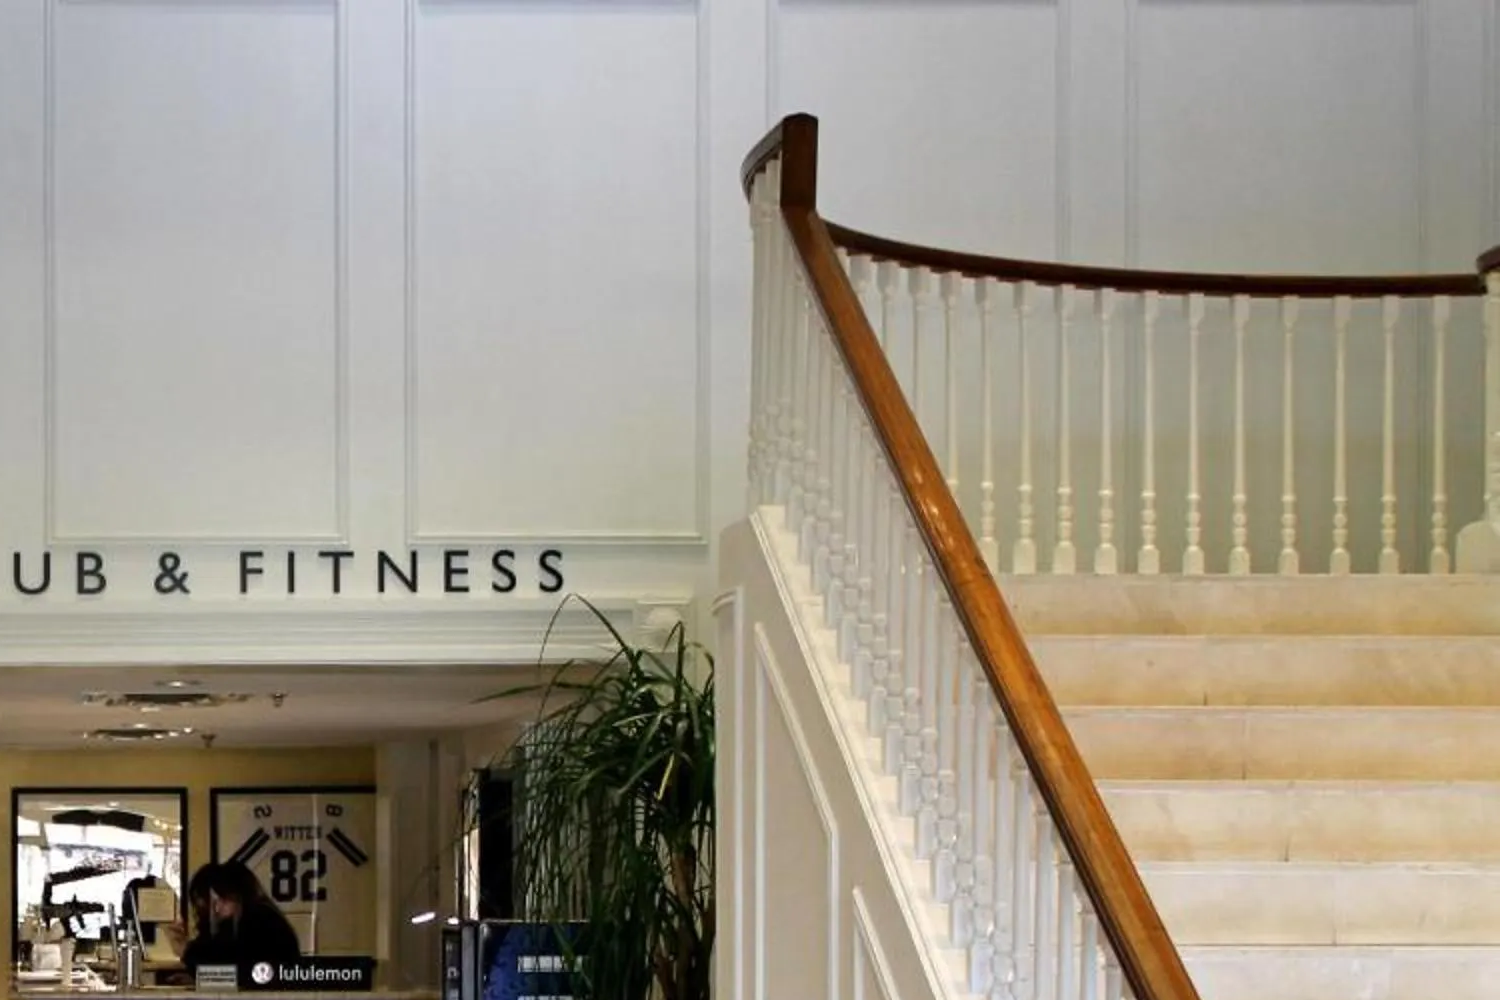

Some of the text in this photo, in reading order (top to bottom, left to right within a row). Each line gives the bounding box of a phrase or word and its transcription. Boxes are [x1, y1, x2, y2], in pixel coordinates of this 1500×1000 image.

[153, 550, 191, 594] &
[238, 549, 565, 594] FITNESS
[271, 850, 328, 902] 82
[279, 964, 363, 981] lululemon
